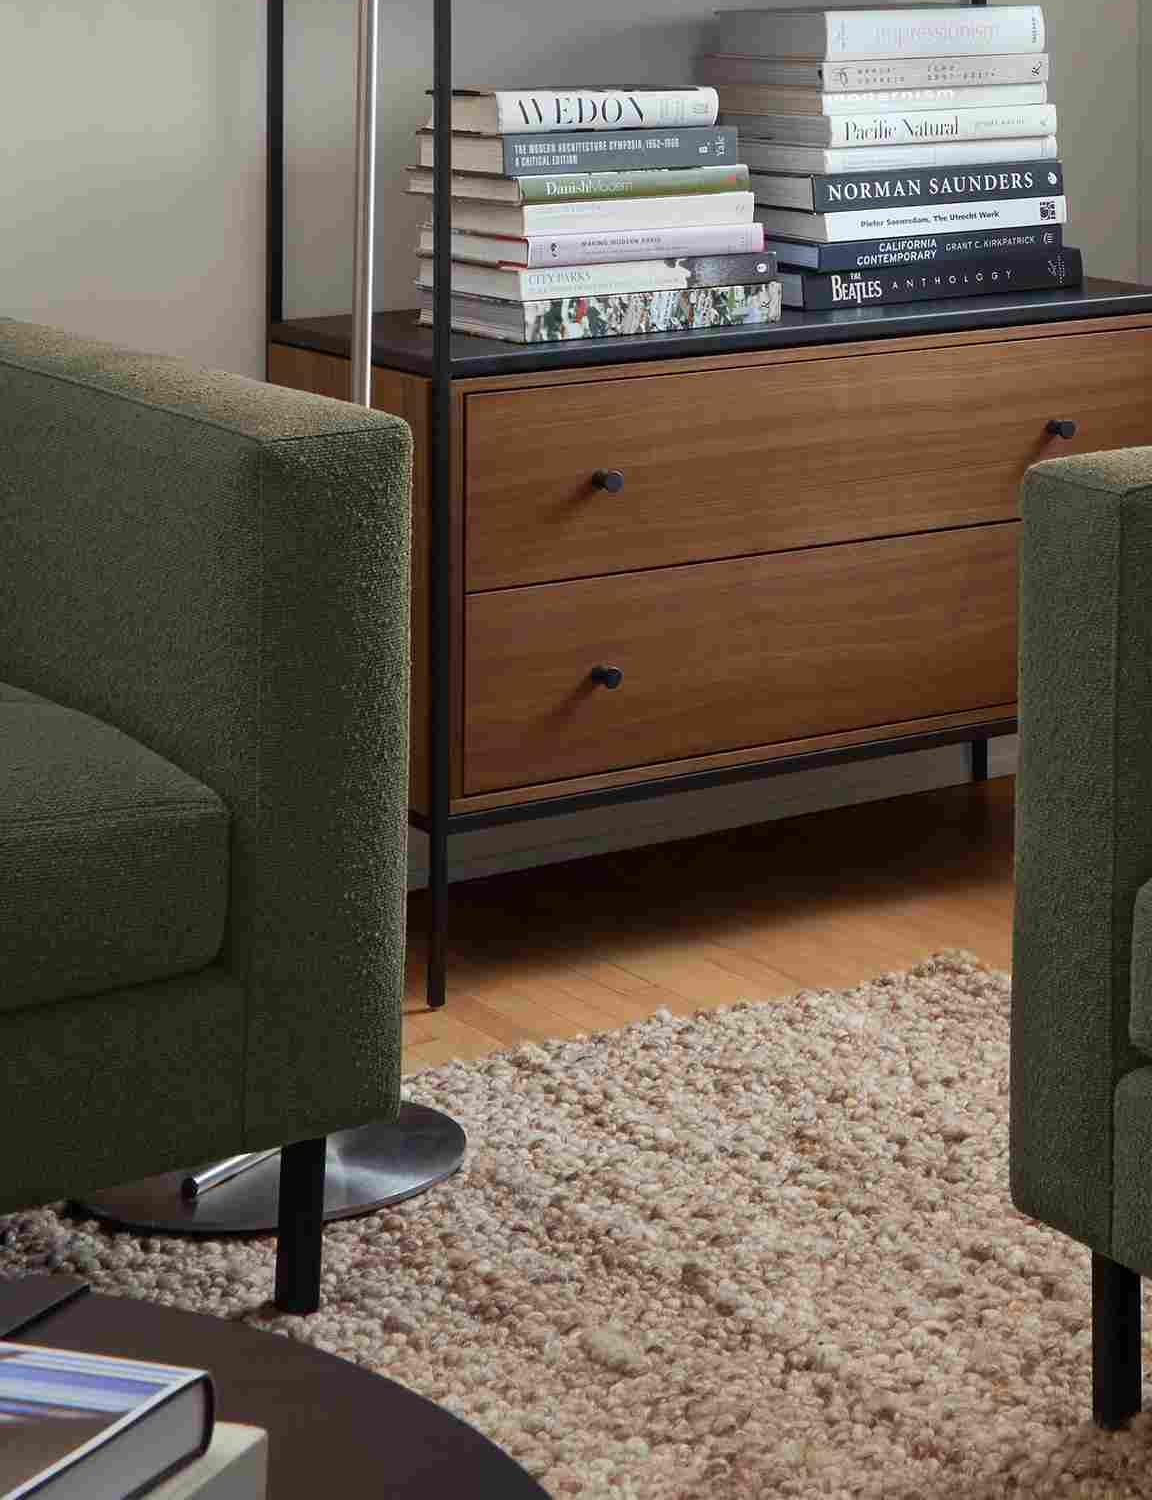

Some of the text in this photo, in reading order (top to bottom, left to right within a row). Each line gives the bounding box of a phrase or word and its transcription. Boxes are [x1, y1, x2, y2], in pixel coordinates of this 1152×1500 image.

[844, 116, 897, 141] Pacific
[902, 115, 960, 138] Natural
[521, 156, 551, 168] CRITICAL
[551, 154, 578, 166] EDITION
[828, 171, 1034, 202] NORMAN SAUNDERS
[933, 214, 948, 223] The
[949, 212, 977, 222] Utrecht
[978, 209, 1000, 220] Work
[879, 238, 938, 253] CALIFORNIA
[945, 240, 973, 252] GRANT
[983, 235, 1035, 249] KIRKPATRICK
[856, 249, 938, 267] CONTEMPORARY
[831, 274, 883, 304] BEATLES
[890, 269, 1014, 291] ANTHOLOGY
